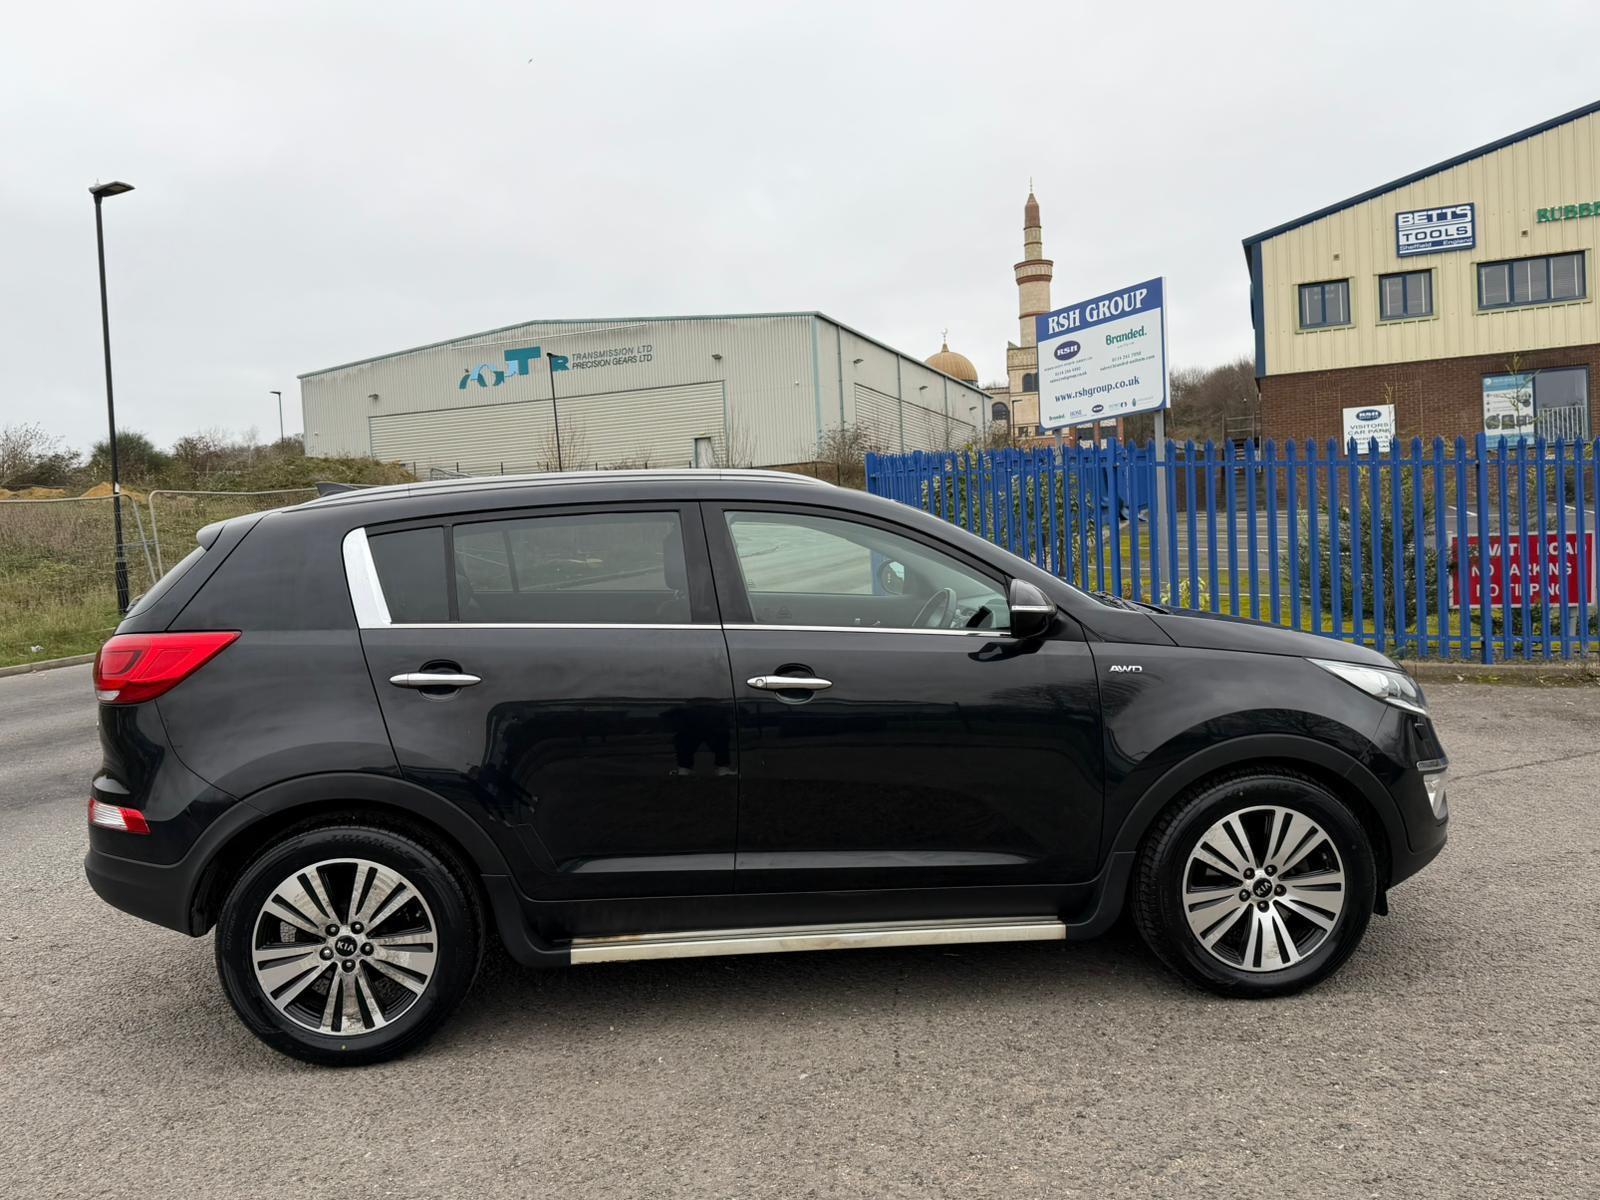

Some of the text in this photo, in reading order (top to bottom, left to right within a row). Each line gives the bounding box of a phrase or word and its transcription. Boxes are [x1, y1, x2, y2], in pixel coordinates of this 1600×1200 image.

[1398, 205, 1472, 225] BETTS
[1402, 226, 1468, 242] TOOLS
[1399, 237, 1472, 250] Sheffield England
[1048, 288, 1148, 335] RSH GROUP
[572, 344, 653, 361] TRANSMISSION LTD
[1057, 344, 1078, 356] RSH
[572, 354, 653, 370] PRECISION GEARS LTD
[1055, 375, 1140, 402] www.rshgroup.co.uk
[1350, 422, 1389, 430] VISITORS
[1109, 665, 1143, 673] AWD
[1255, 882, 1271, 896] KIA
[336, 941, 355, 952] KIA
